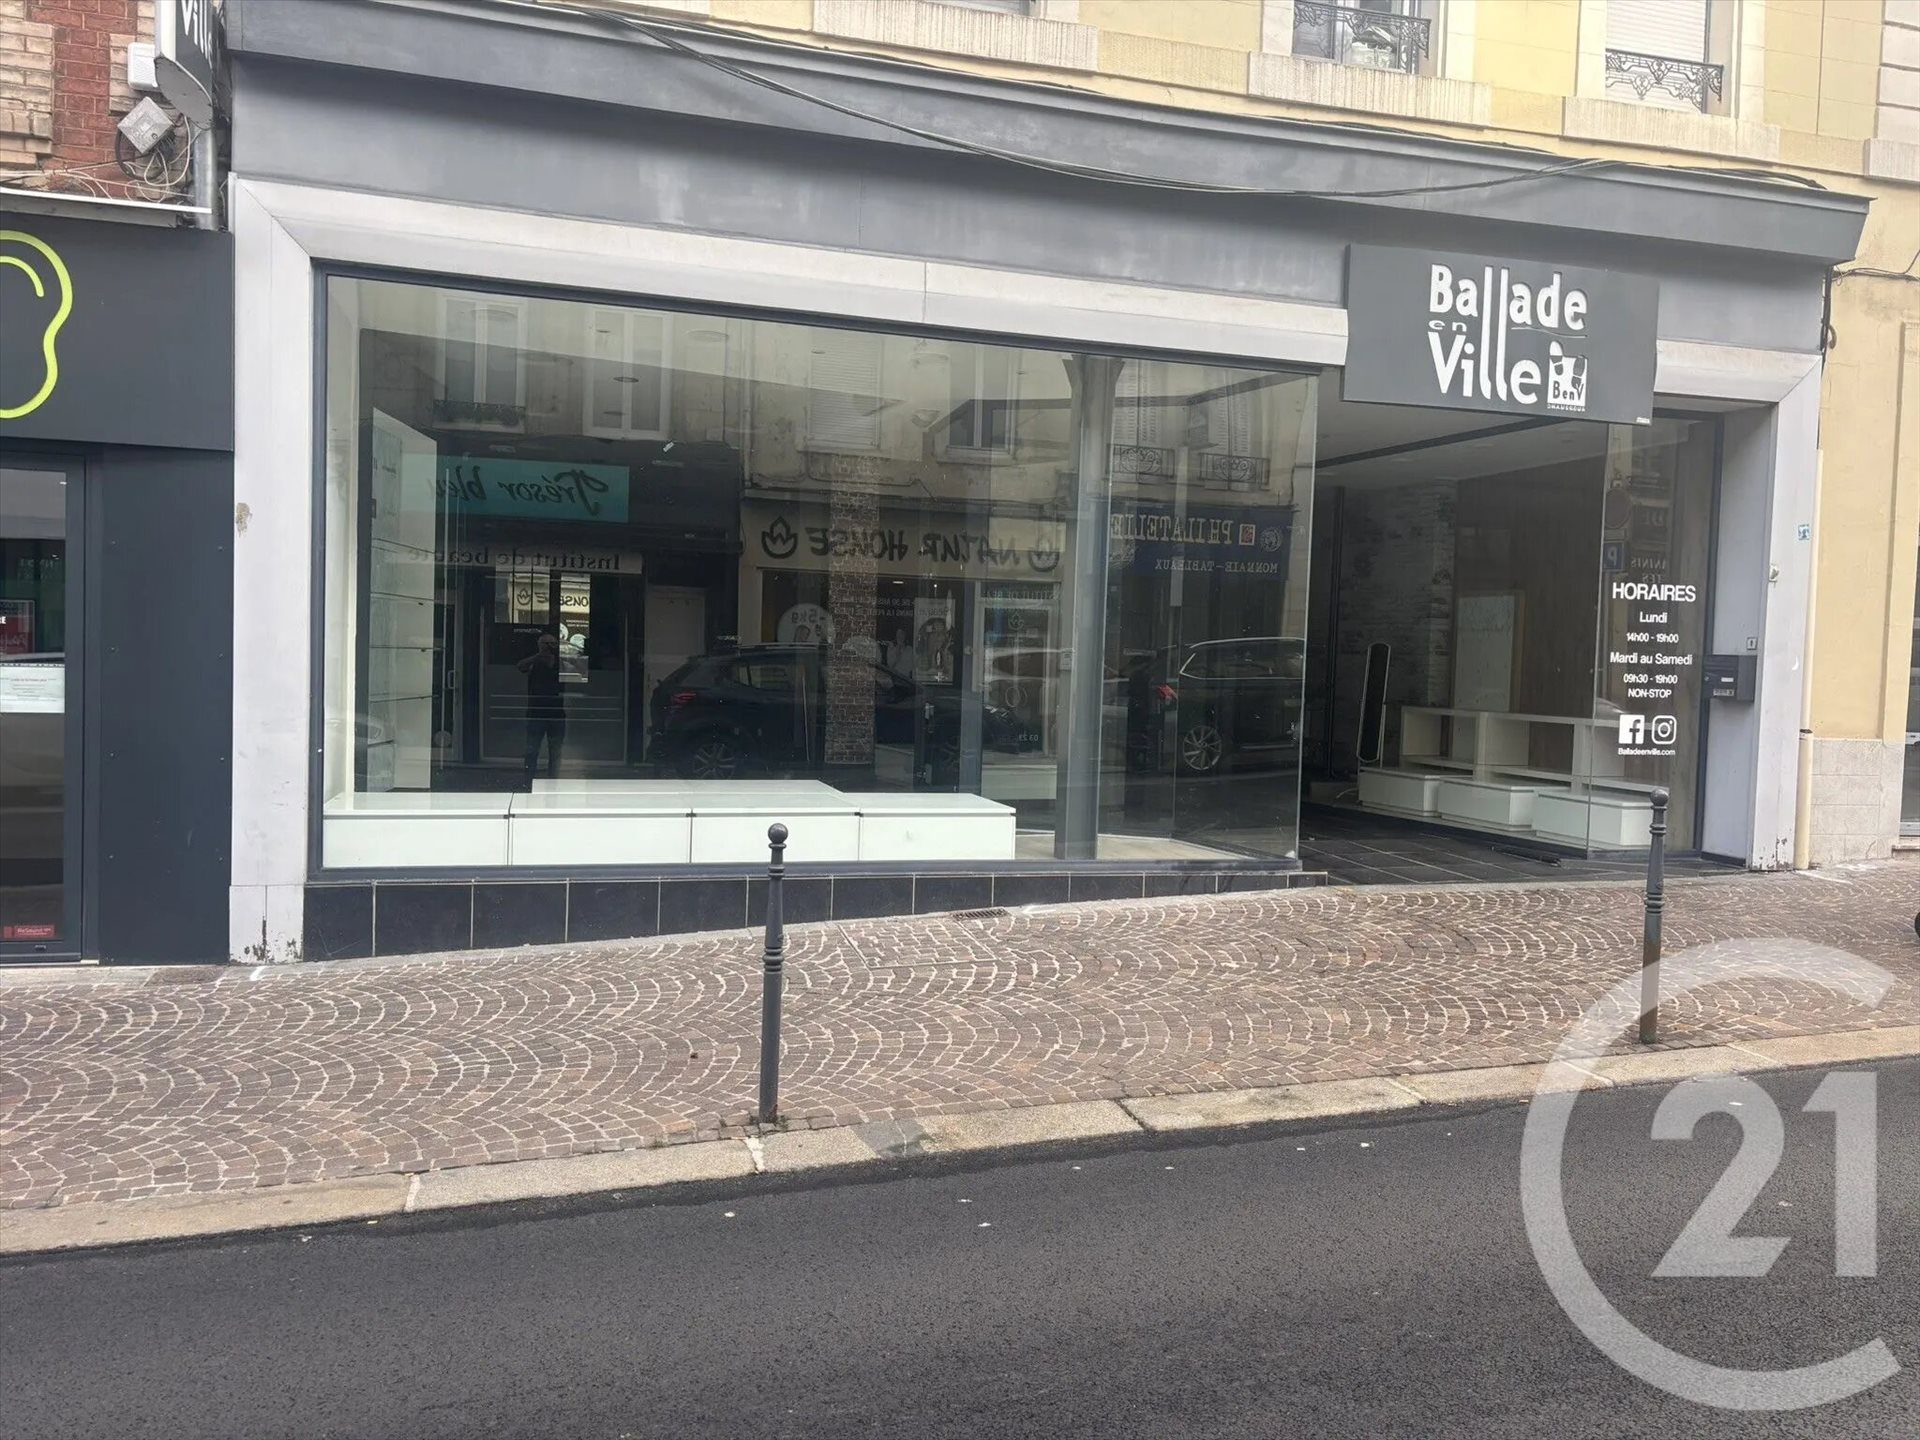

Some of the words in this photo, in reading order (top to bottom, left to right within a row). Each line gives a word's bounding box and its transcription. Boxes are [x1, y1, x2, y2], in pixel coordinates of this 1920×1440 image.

[1430, 264, 1587, 331] Ballade
[1429, 320, 1468, 332] en
[1428, 330, 1542, 405] Ville
[1612, 582, 1697, 602] HORAIRES
[1639, 611, 1668, 623] Lundi
[1626, 632, 1650, 642] 14h00
[1656, 633, 1679, 643] 19h00
[1610, 651, 1638, 664] Mardi
[1640, 654, 1653, 664] au
[1655, 653, 1693, 665] Samedi
[1623, 674, 1648, 684] 09h30
[1655, 674, 1678, 684] 19h00
[1628, 688, 1672, 698] NON-STOP
